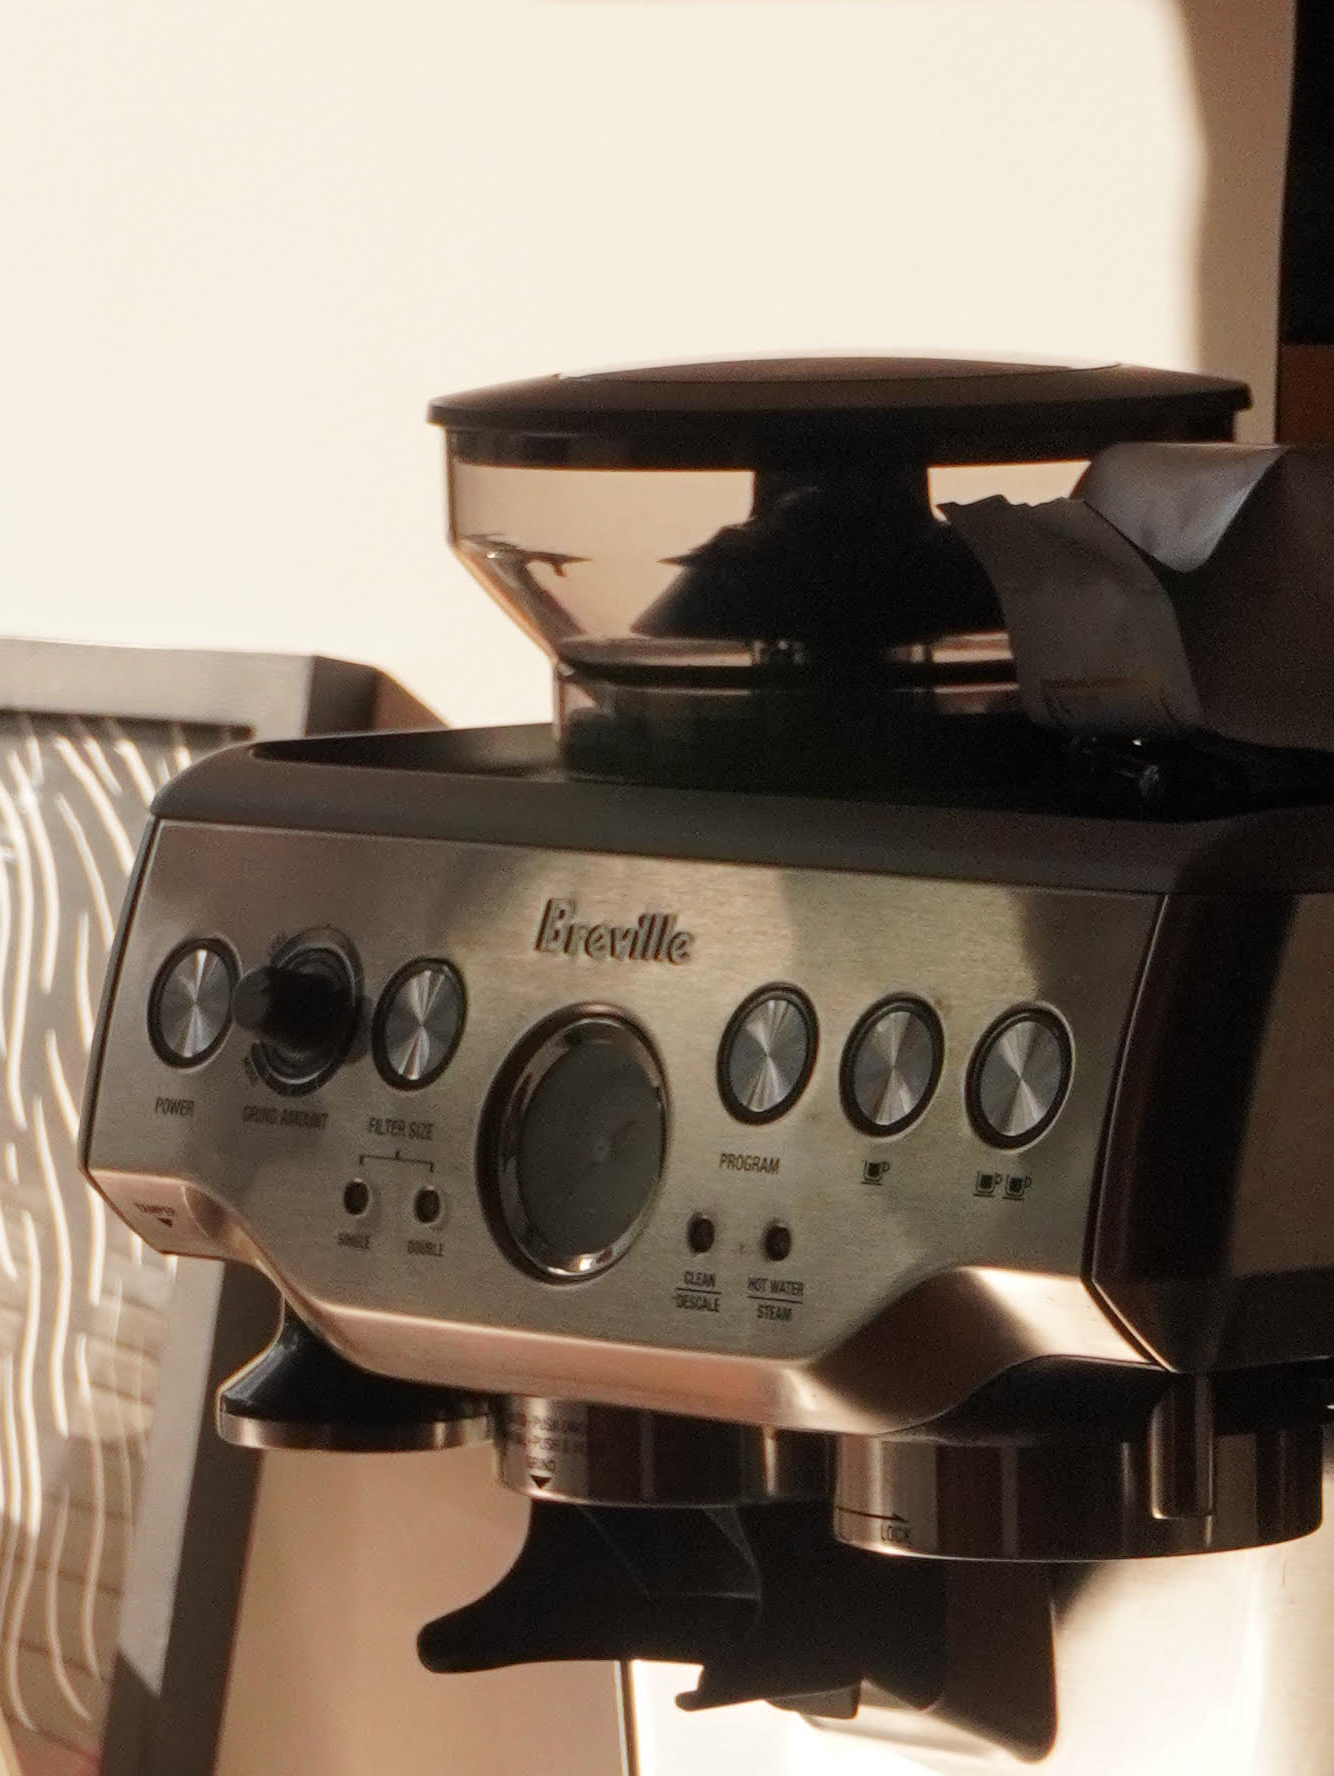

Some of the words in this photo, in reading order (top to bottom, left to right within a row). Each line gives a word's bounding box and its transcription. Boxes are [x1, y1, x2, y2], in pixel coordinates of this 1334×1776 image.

[534, 897, 695, 966] Breville
[154, 1096, 195, 1117] POWER
[367, 1117, 405, 1137] FILTER
[407, 1121, 434, 1141] SIZE
[719, 1152, 780, 1175] PROGRAM
[684, 1271, 716, 1288] CLEAN
[770, 1280, 804, 1297] WATER
[756, 1304, 792, 1322] STEAM
